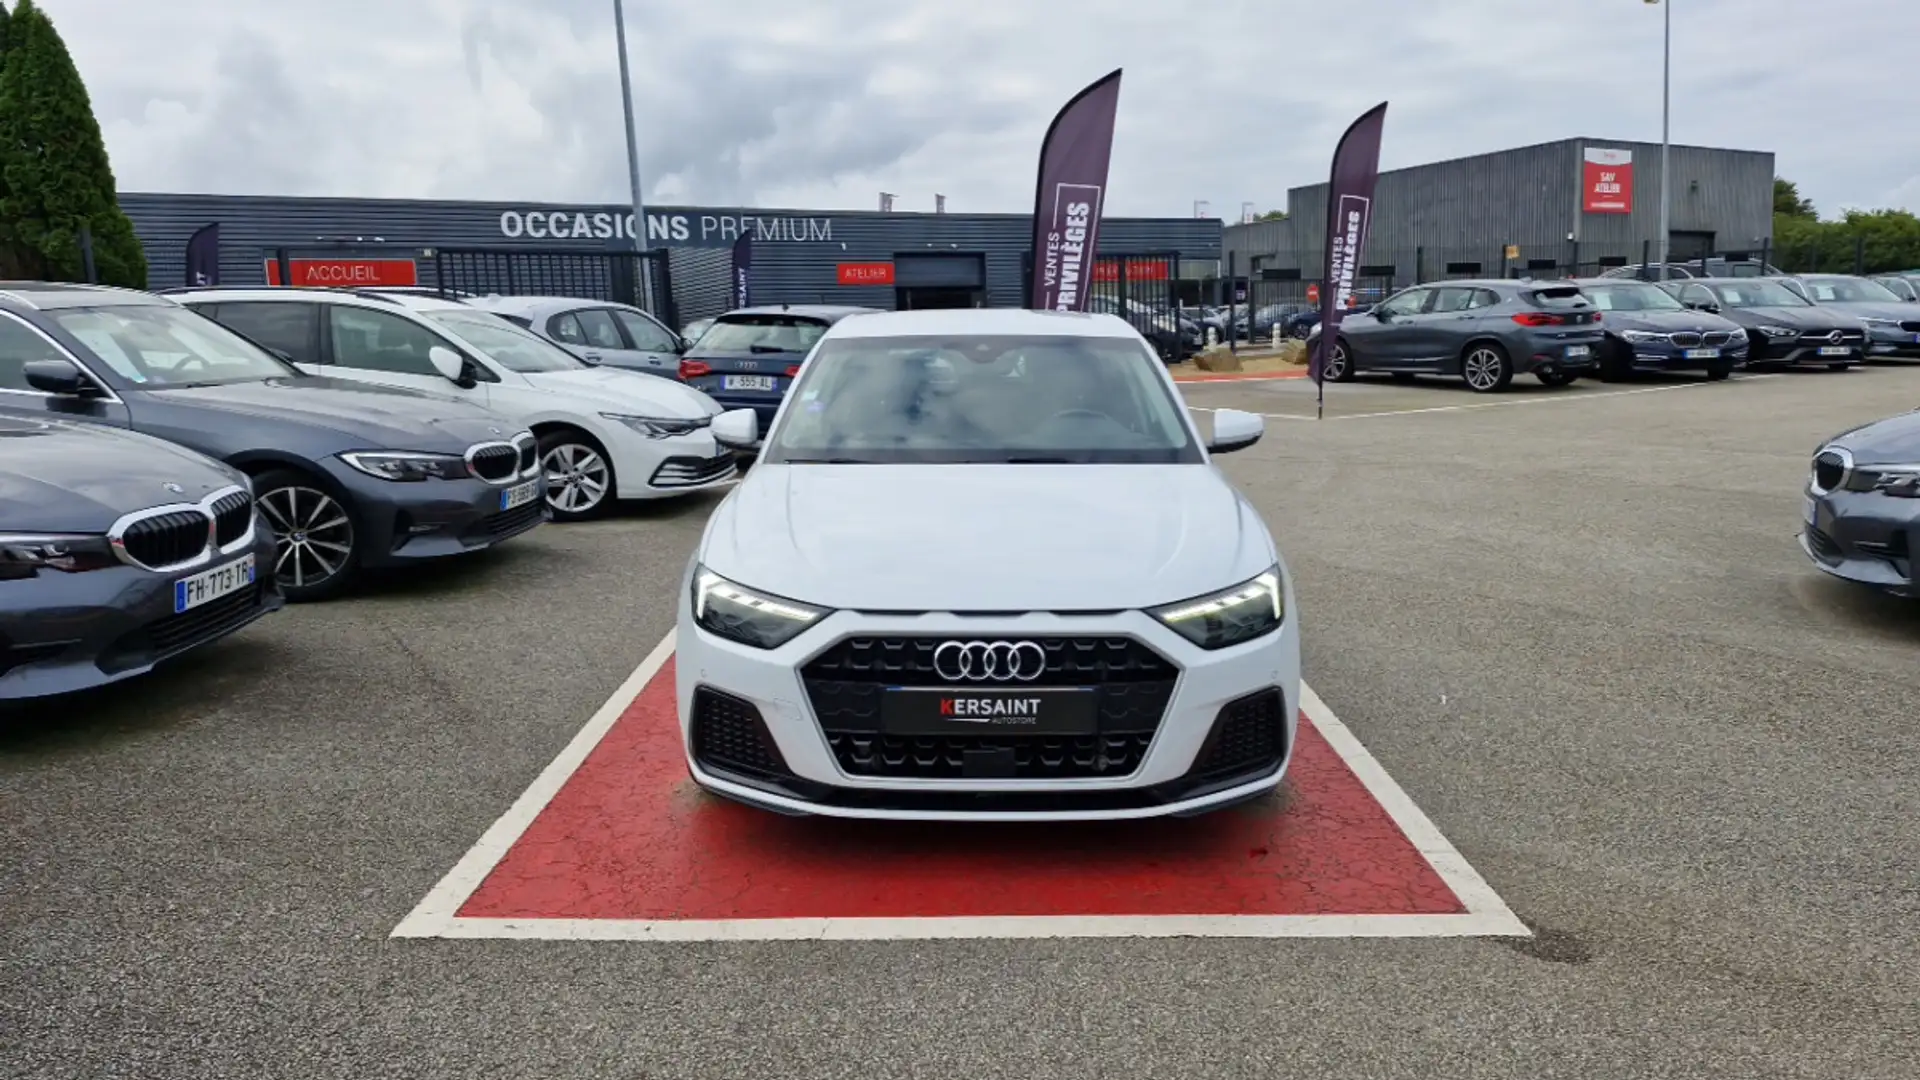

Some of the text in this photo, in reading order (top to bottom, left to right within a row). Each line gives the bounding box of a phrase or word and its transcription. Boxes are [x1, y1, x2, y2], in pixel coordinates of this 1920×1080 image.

[1044, 231, 1060, 286] VENTES
[1330, 236, 1343, 283] VENTES
[307, 265, 380, 281] ACCUEIL
[845, 268, 887, 279] ATELIER
[940, 698, 1041, 715] KERSAINT
[992, 716, 1036, 725] AUTOSTORE
